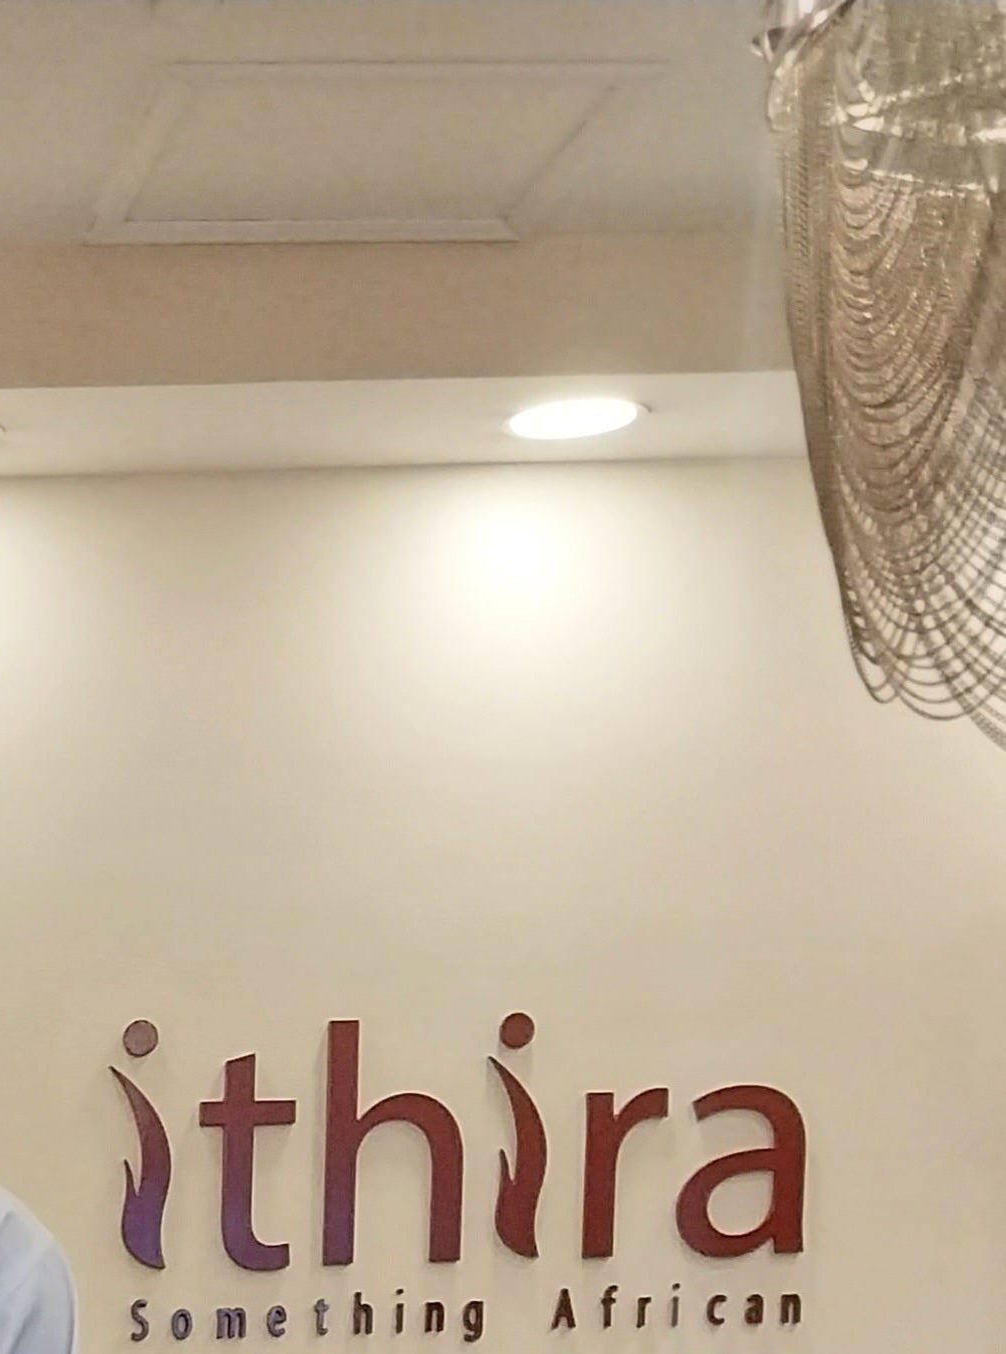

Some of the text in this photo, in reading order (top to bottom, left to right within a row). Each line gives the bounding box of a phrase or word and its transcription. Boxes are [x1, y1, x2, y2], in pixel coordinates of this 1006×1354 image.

[109, 1012, 806, 1271] ithira
[129, 1284, 804, 1343] Something African
